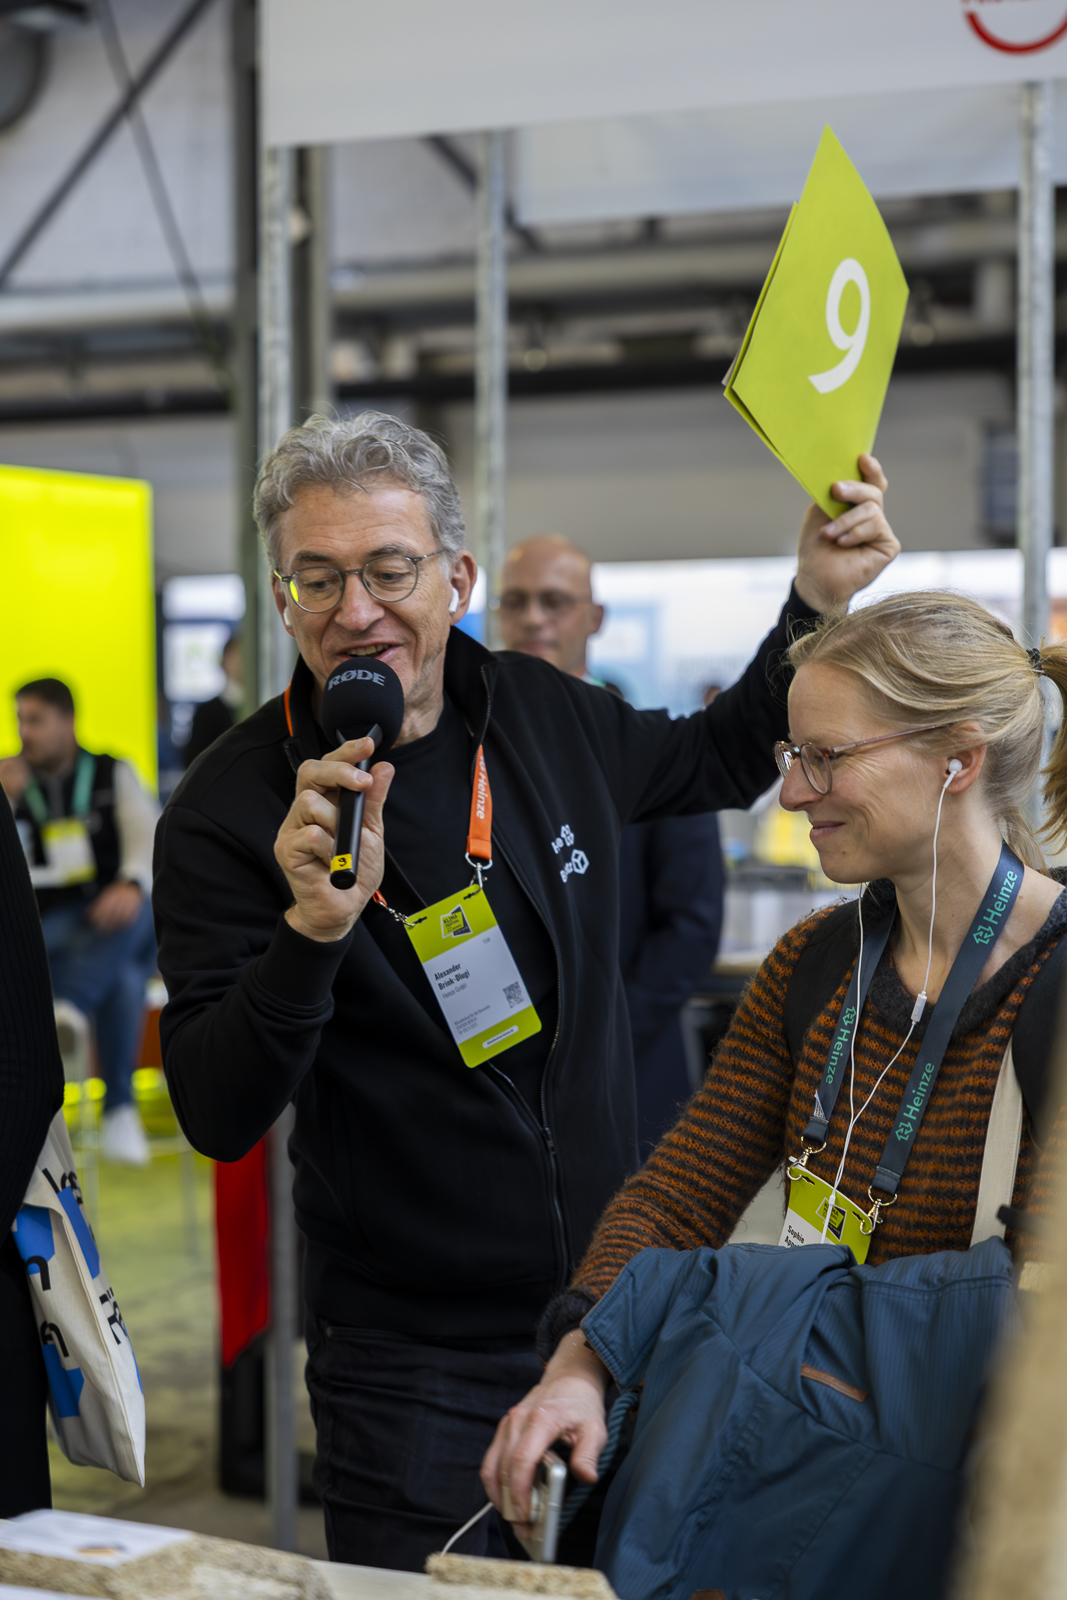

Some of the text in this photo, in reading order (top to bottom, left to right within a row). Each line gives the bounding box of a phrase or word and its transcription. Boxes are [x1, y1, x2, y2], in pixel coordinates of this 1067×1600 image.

[807, 257, 870, 394] 9
[327, 669, 386, 691] RØDE
[476, 772, 488, 819] Heinze
[983, 870, 1018, 925] Heinze
[434, 963, 461, 981] Alexander
[825, 1029, 850, 1085] Heinze
[903, 1062, 935, 1121] Heinze
[787, 1225, 805, 1244] Sophie
